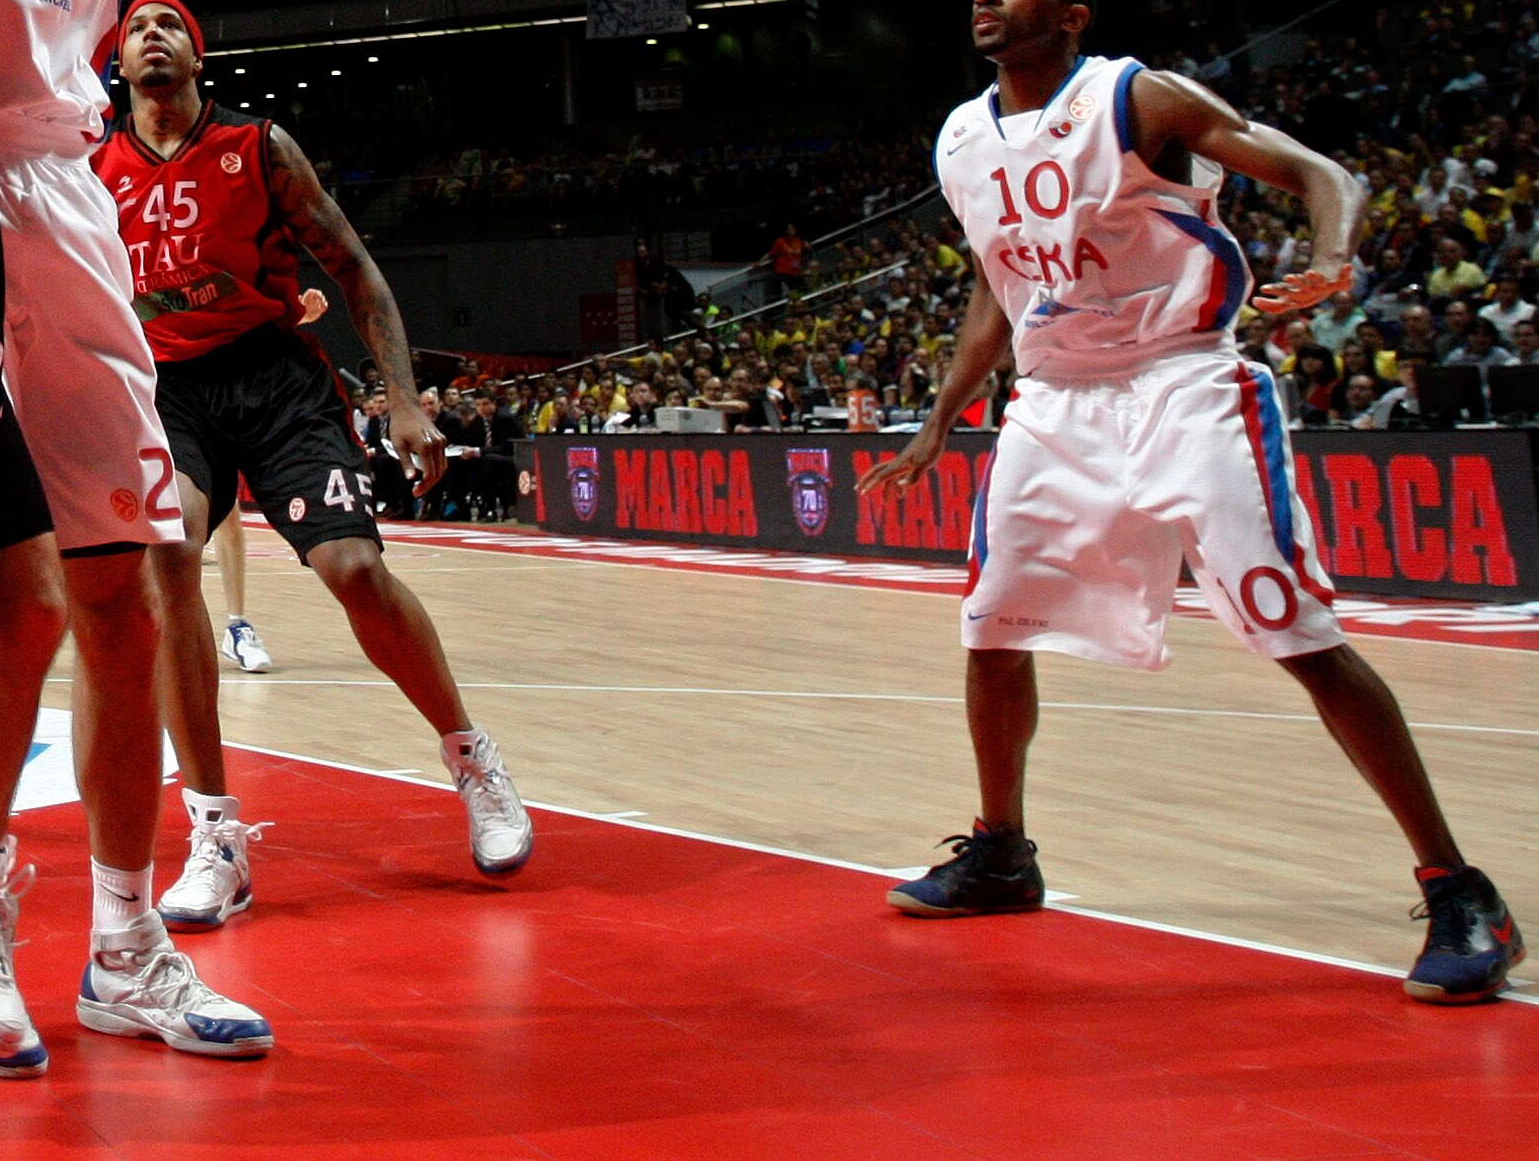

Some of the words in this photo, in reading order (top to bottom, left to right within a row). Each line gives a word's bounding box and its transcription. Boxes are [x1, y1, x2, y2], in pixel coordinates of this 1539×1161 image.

[141, 180, 199, 232] 45
[990, 160, 1070, 226] 10
[127, 233, 205, 278] TAU
[999, 237, 1108, 284] CSKA
[138, 446, 182, 522] 2
[322, 468, 374, 519] 45
[612, 447, 759, 537] MARCA
[851, 449, 993, 551] MAR
